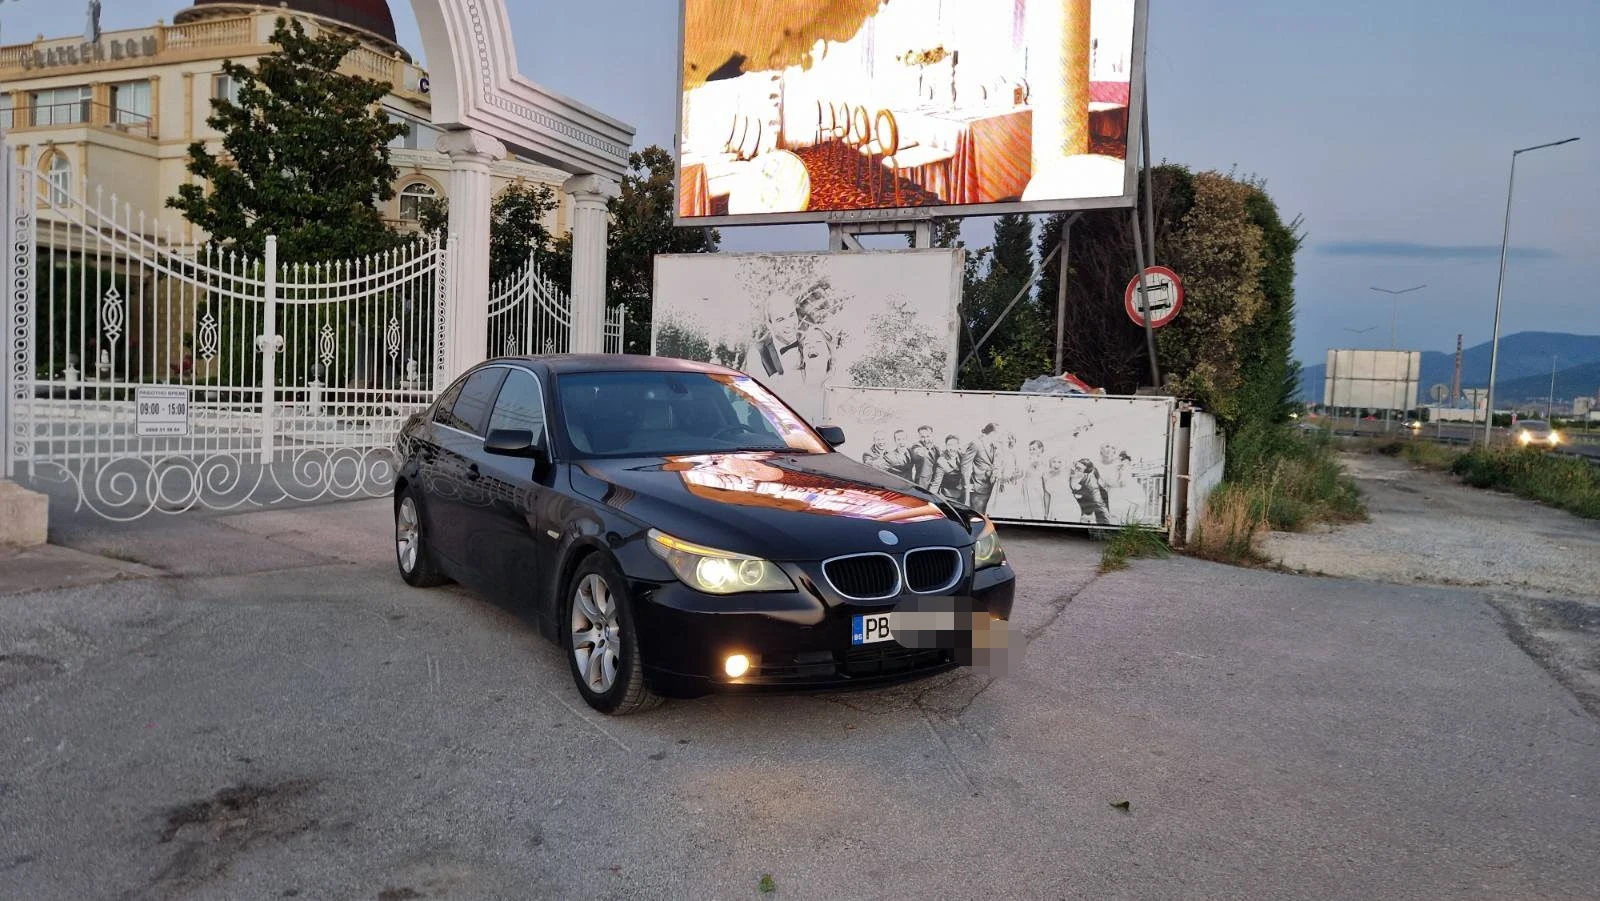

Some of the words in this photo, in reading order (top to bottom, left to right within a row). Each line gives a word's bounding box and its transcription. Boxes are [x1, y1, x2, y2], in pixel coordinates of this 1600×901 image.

[140, 403, 159, 415] 09:00
[168, 403, 185, 415] 15:00
[865, 617, 890, 640] PB
